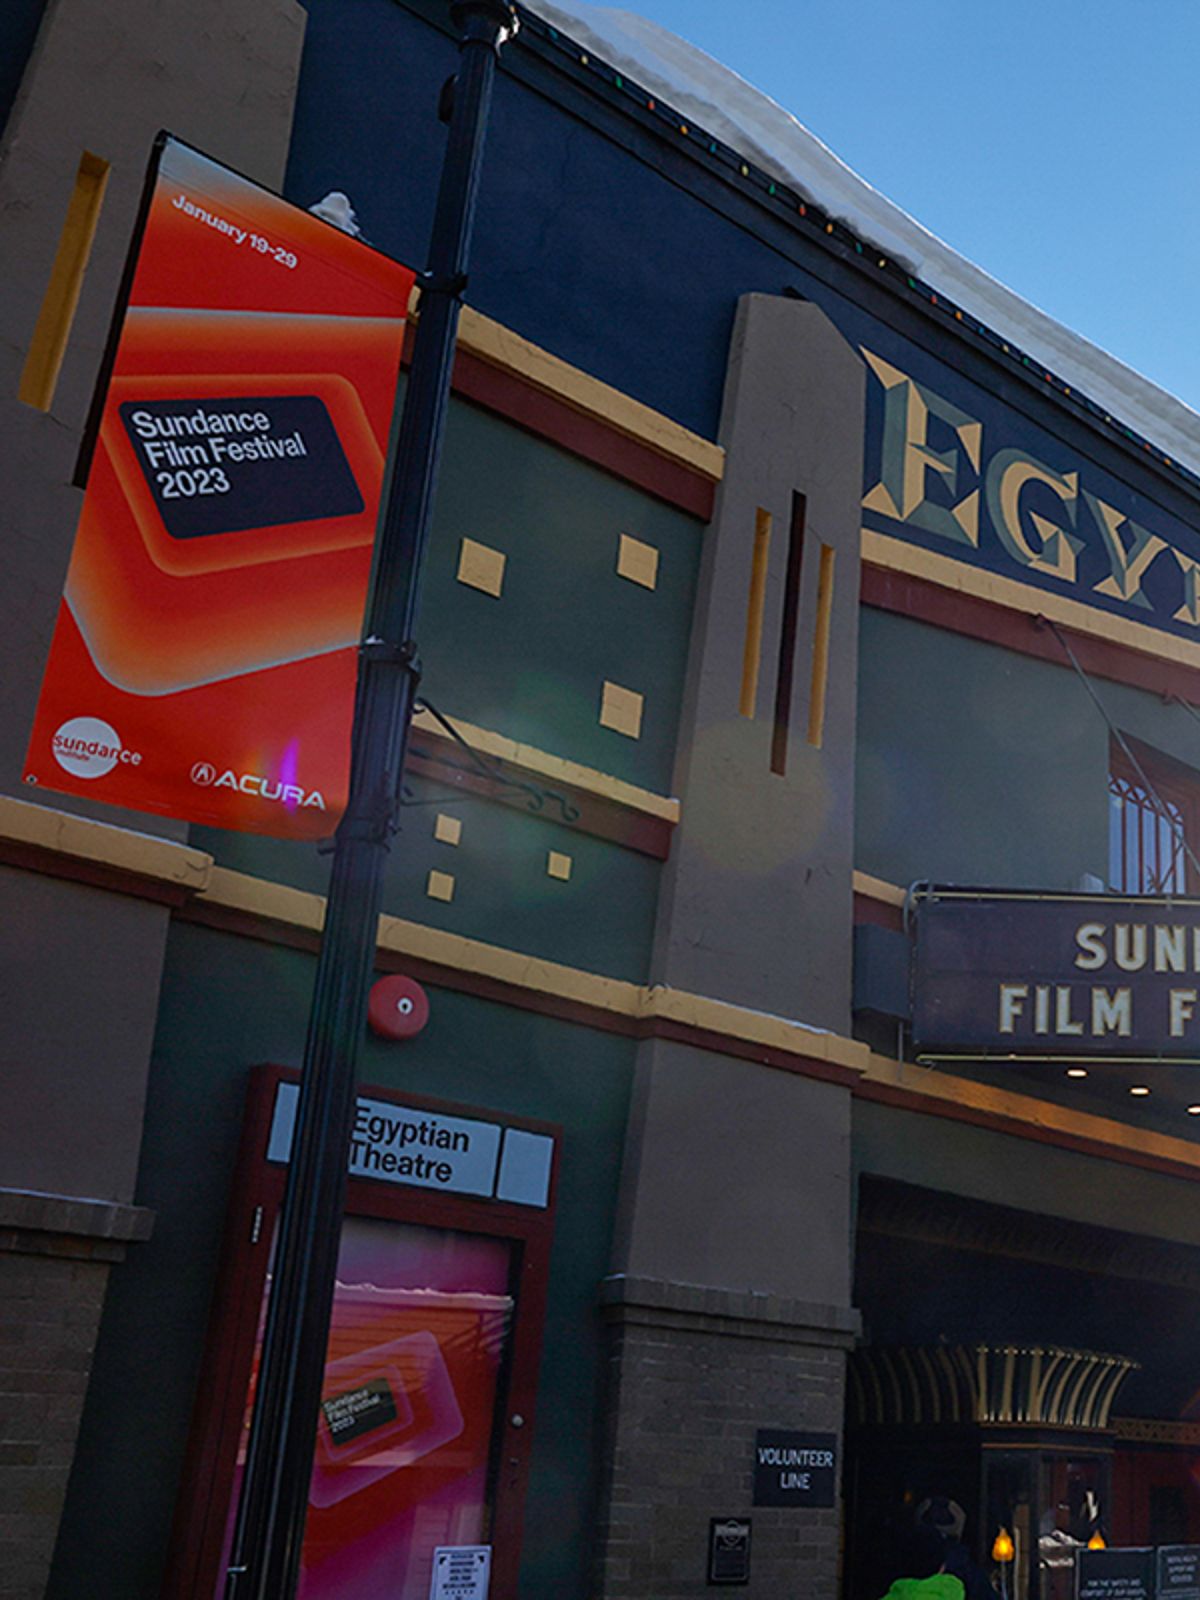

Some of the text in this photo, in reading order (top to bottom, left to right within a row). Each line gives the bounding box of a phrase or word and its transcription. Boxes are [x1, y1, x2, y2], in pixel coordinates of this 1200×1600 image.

[171, 195, 298, 269] January 19-29
[131, 409, 271, 439] Sundance
[145, 432, 307, 469] Film Festival
[157, 468, 231, 499] 2023
[54, 734, 142, 766] sundance
[213, 770, 326, 810] ACURA
[999, 983, 1132, 1038] FILM
[353, 1106, 470, 1153] Egyptian
[350, 1139, 454, 1184] Theatre
[757, 1447, 834, 1468] VOLUNTEER
[780, 1472, 811, 1490] LINE
